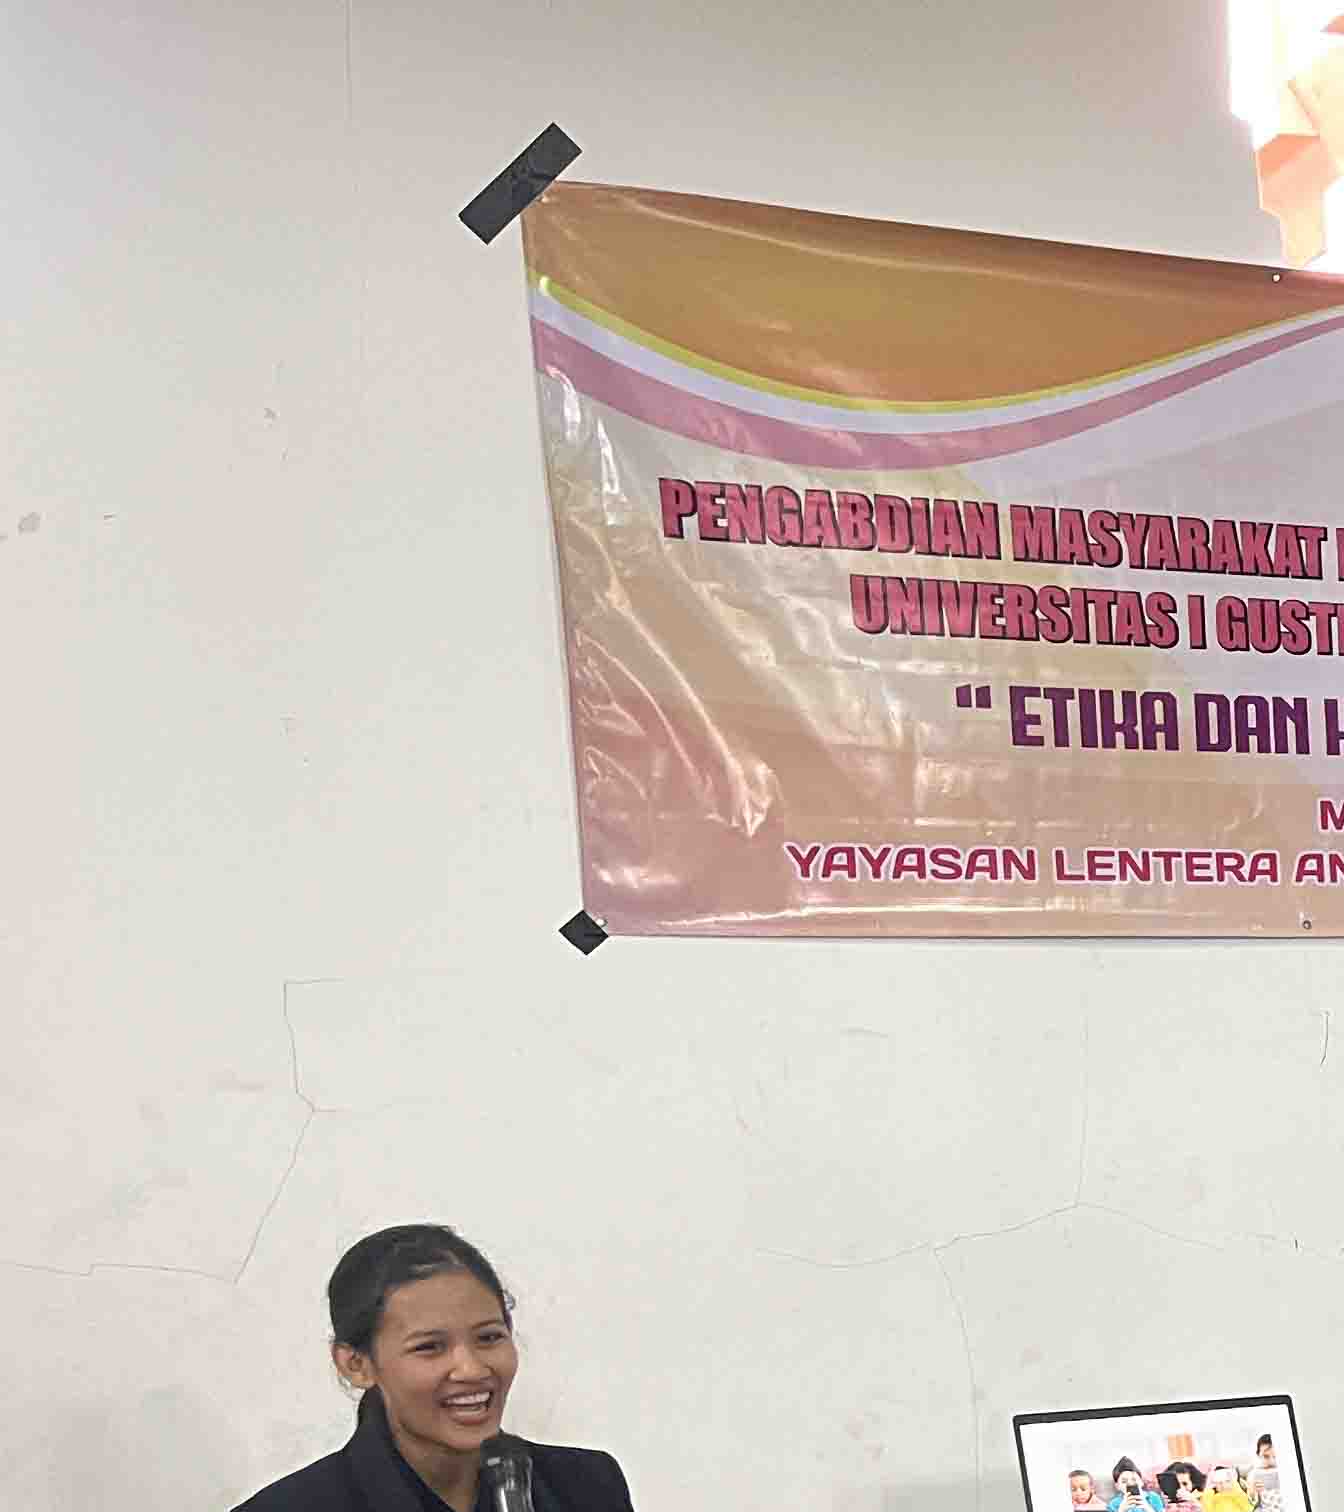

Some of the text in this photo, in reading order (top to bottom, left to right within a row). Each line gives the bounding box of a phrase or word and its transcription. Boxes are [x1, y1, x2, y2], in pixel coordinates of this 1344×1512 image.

[659, 478, 1000, 560] PENGABDIAN
[1009, 504, 1327, 579] MASYARAKAT
[849, 574, 1179, 648] UNIVERSITAS
[1188, 594, 1207, 649] I
[1009, 685, 1180, 752] ETIKA
[1194, 692, 1311, 756] DAN
[785, 845, 1037, 882] YAYASAN
[1054, 848, 1279, 885] LENTERA
